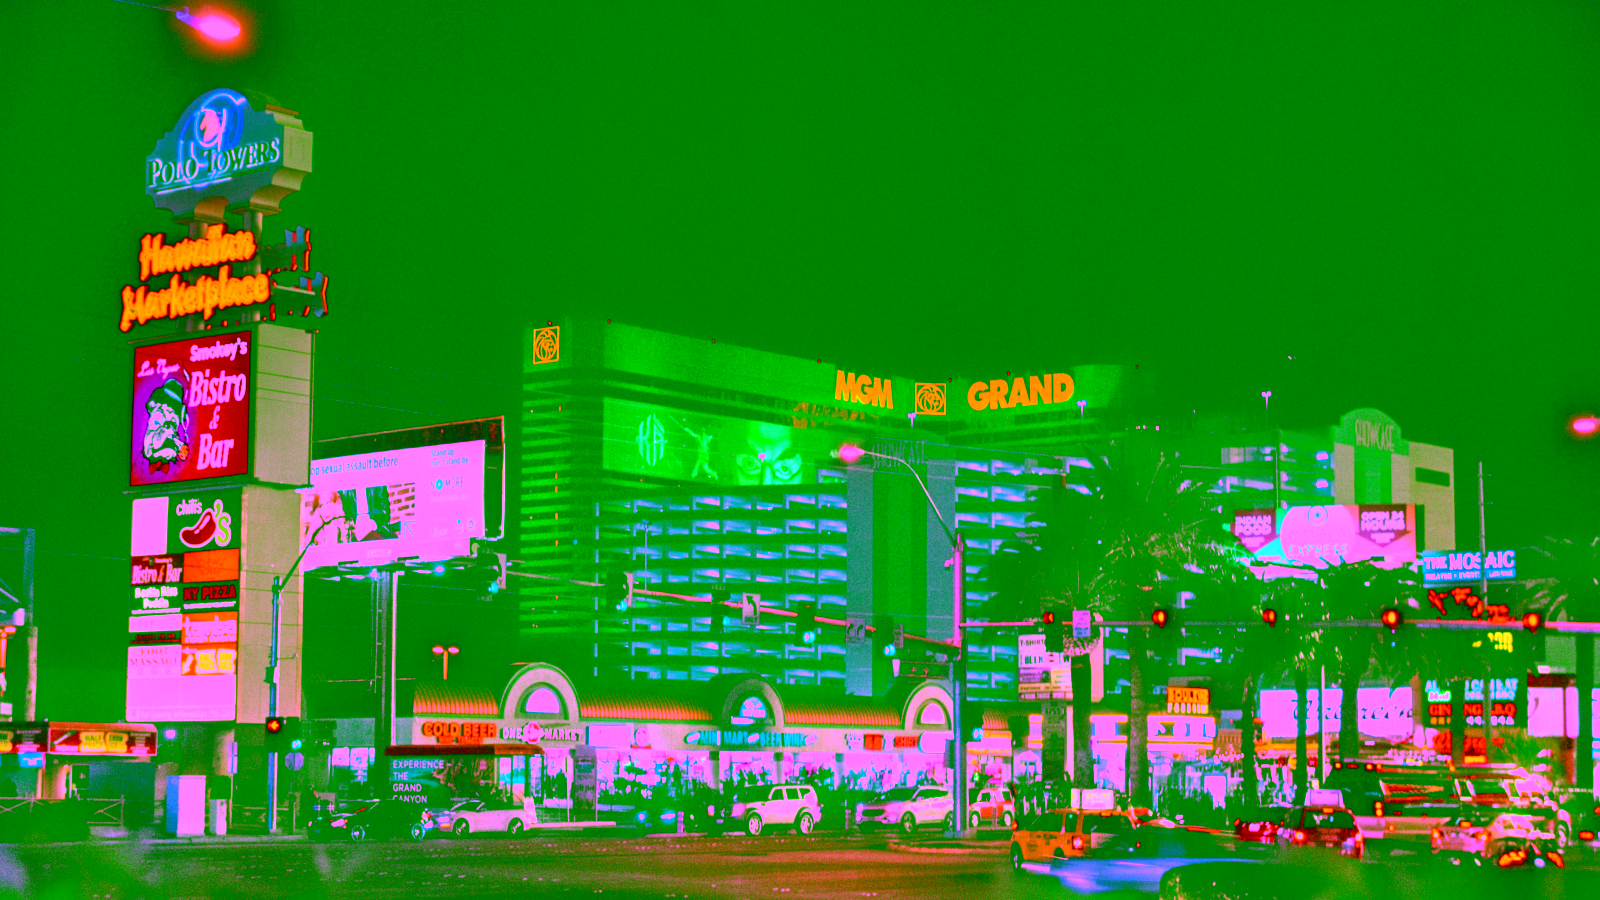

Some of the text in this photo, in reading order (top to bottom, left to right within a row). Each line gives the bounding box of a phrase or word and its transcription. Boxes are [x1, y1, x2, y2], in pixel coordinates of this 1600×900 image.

[139, 223, 256, 282] Hawaiian
[120, 264, 270, 332] Marketplace
[190, 338, 248, 362] Smokey's
[188, 369, 246, 407] Bistro
[835, 370, 1074, 411] MGM GRAND
[209, 406, 220, 429] &
[197, 433, 234, 470] Bar
[321, 462, 344, 473] sexual
[346, 457, 372, 471] assault
[373, 456, 398, 469] before
[1360, 510, 1404, 521] OPEN 24
[1235, 524, 1272, 536] FOOD
[1360, 519, 1405, 531] HOURS
[1289, 543, 1348, 557] EXPRESS
[1424, 551, 1515, 570] THE MOSAIC
[131, 565, 157, 584] Bistro
[166, 564, 182, 582] Bar
[183, 588, 199, 600] NY
[201, 585, 236, 600] PIZZA
[422, 721, 497, 738] COLD BEER
[502, 727, 523, 740] ONE
[544, 728, 584, 741] MARKET
[393, 760, 444, 769] EXPERIENCE
[393, 771, 408, 780] THE
[393, 783, 422, 793] GRAND
[393, 795, 427, 804] CANYON
